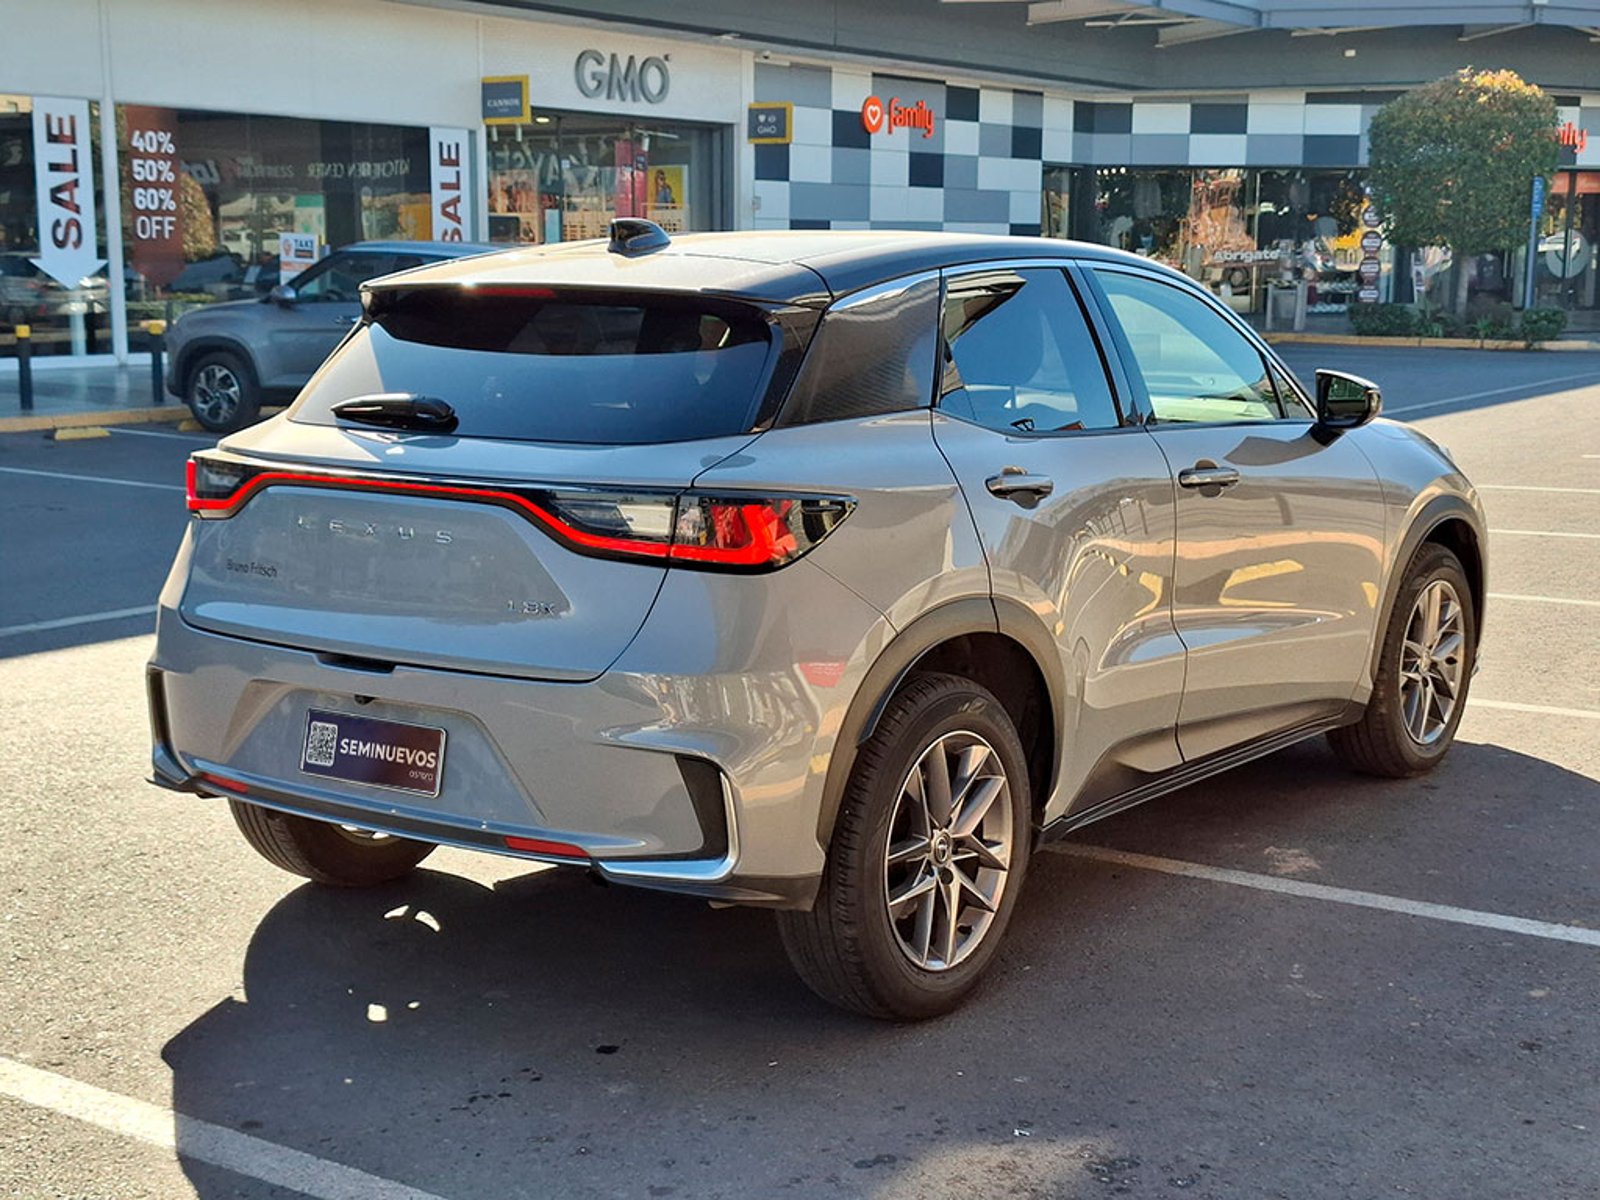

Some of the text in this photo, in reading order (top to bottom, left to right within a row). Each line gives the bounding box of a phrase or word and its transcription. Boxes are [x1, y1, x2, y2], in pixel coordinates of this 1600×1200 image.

[575, 49, 670, 104] GMO
[888, 96, 935, 139] family
[131, 130, 176, 154] 40%
[45, 113, 83, 250] SALE
[131, 158, 176, 182] 50%
[133, 187, 177, 211] 60%
[136, 215, 177, 239] OFF
[297, 514, 453, 544] LEXUS
[340, 738, 437, 769] SEMINUEVOS
